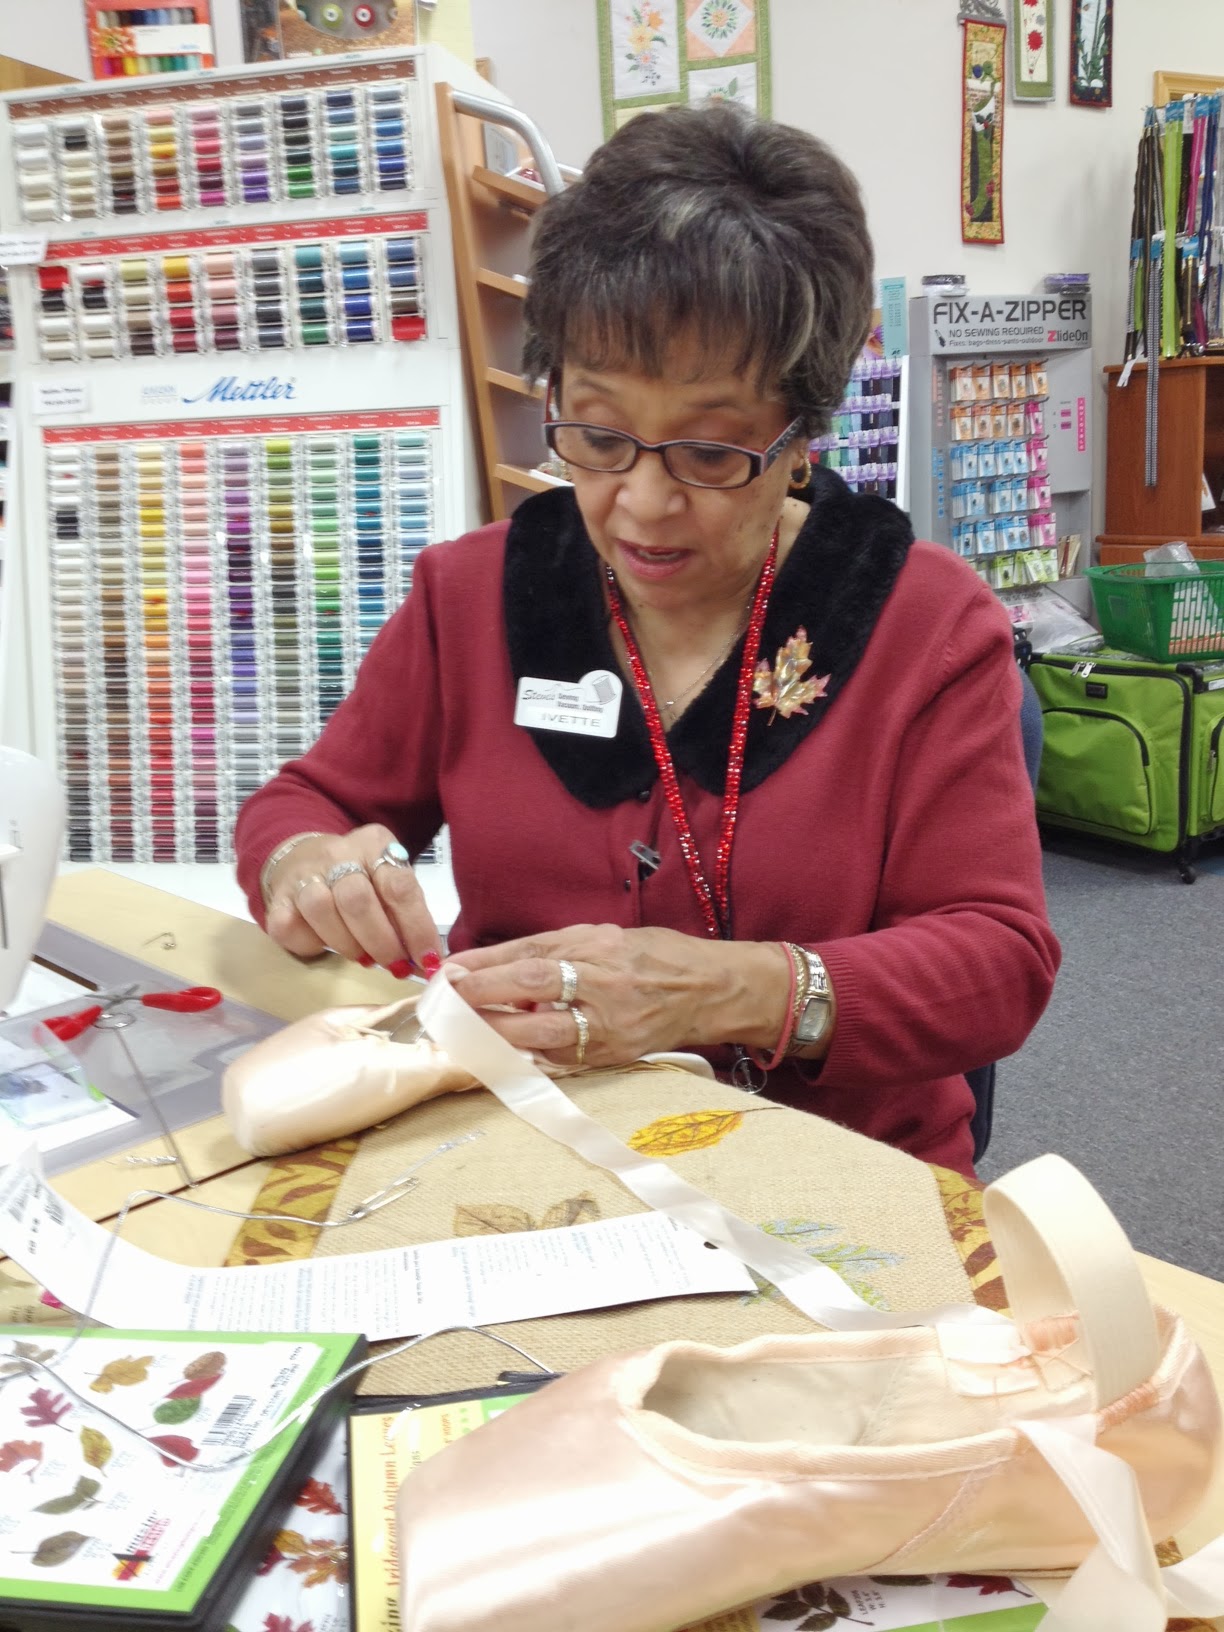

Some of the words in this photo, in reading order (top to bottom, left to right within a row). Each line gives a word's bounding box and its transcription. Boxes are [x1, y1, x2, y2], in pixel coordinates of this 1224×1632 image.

[933, 299, 1087, 324] FIX-A-ZIPPER
[949, 329, 962, 338] NO
[965, 327, 1000, 337] SEWING
[1002, 326, 1044, 336] REQUIRED
[182, 376, 296, 403] Mettler
[541, 713, 601, 727] IVETTE
[383, 1460, 398, 1512] Autumn
